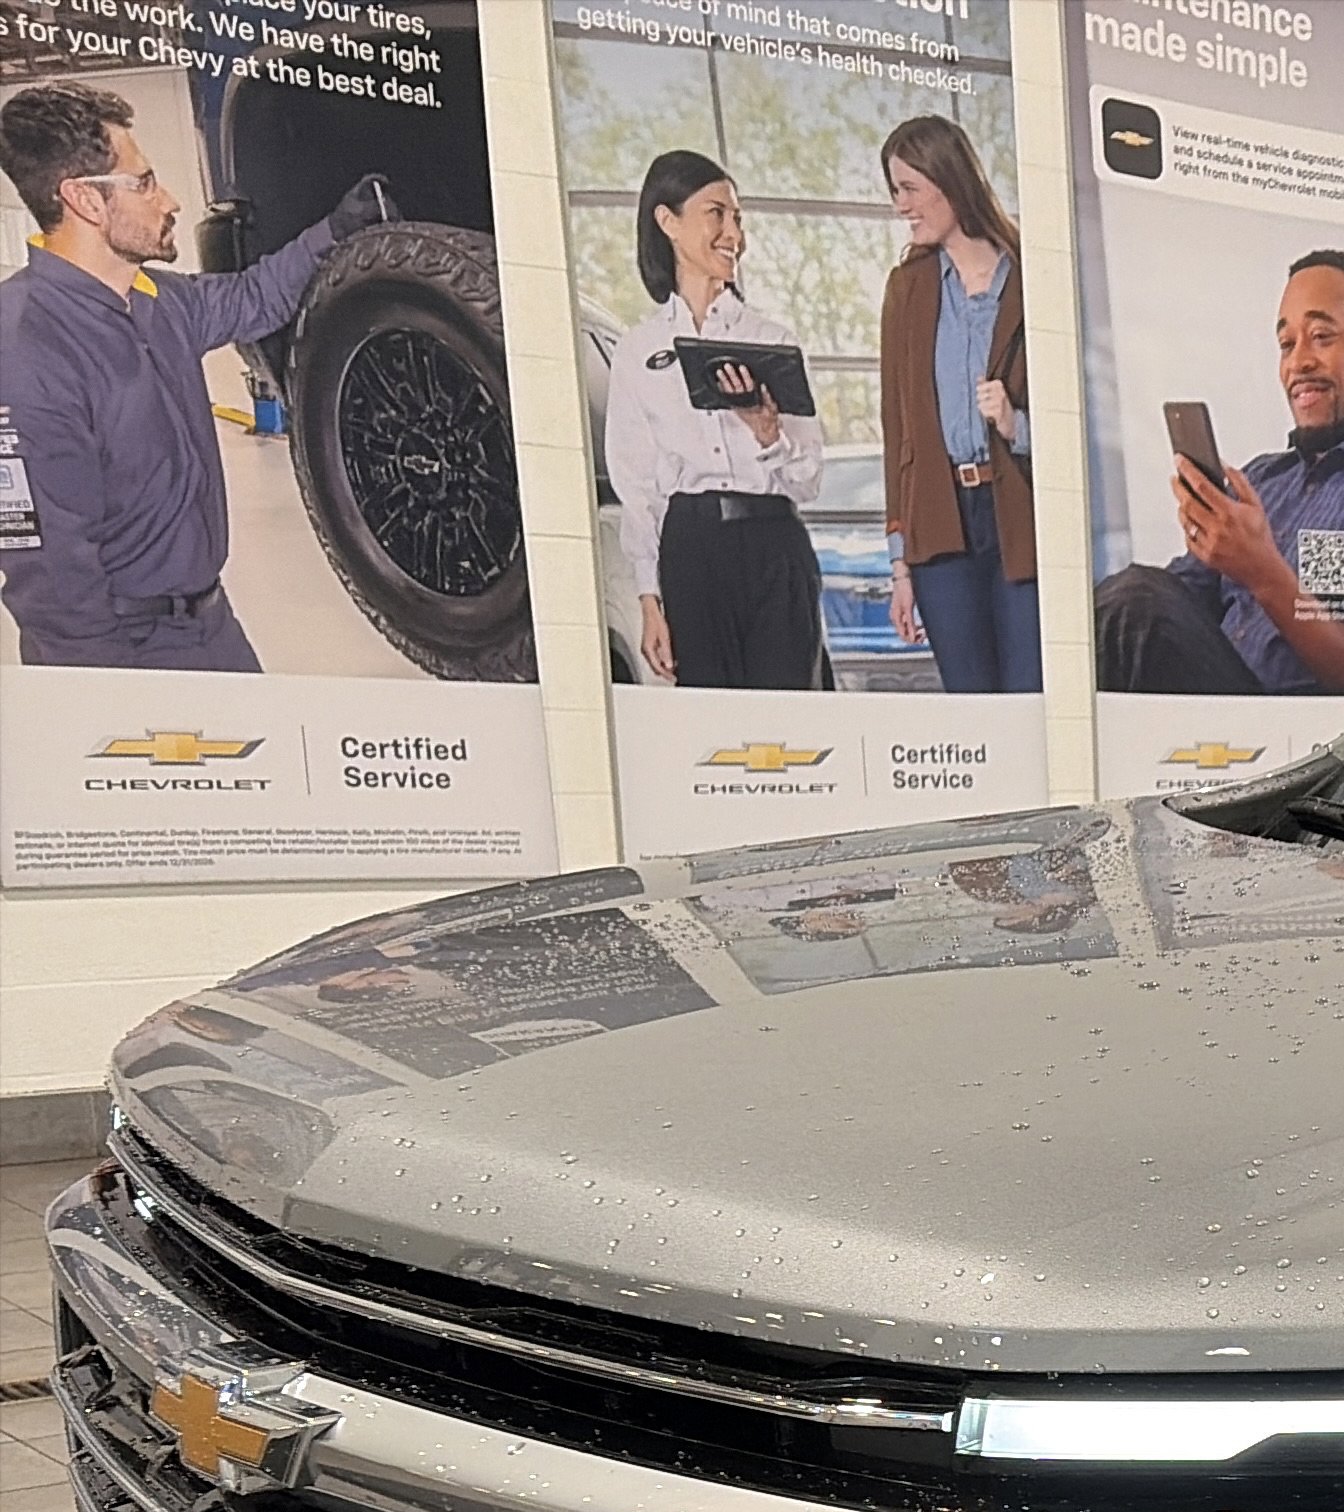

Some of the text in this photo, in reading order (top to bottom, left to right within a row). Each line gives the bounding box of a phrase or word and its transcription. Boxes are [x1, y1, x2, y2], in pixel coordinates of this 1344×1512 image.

[304, 0, 361, 22] your
[367, 3, 432, 40] tires,
[727, 3, 781, 28] mind
[787, 8, 831, 37] that
[836, 22, 906, 51] comes
[910, 31, 960, 62] from
[124, 1, 203, 33] work.
[209, 10, 255, 41] We
[261, 18, 325, 53] have
[330, 32, 375, 62] the
[380, 41, 442, 74] right
[576, 6, 978, 96] getting your vehicle's health checked.
[1085, 11, 1309, 89] made simple
[16, 13, 59, 44] for
[66, 28, 131, 57] your
[138, 35, 225, 77] Chevy
[232, 55, 261, 79] at
[266, 57, 312, 87] the
[317, 64, 377, 98] best
[382, 76, 443, 108] deal.
[340, 735, 468, 762] Certified
[890, 742, 987, 766] Certified
[84, 778, 273, 791] CHEVROLET
[343, 765, 452, 790] Service
[692, 782, 838, 795] CHEVROLET
[892, 767, 974, 791] Service
